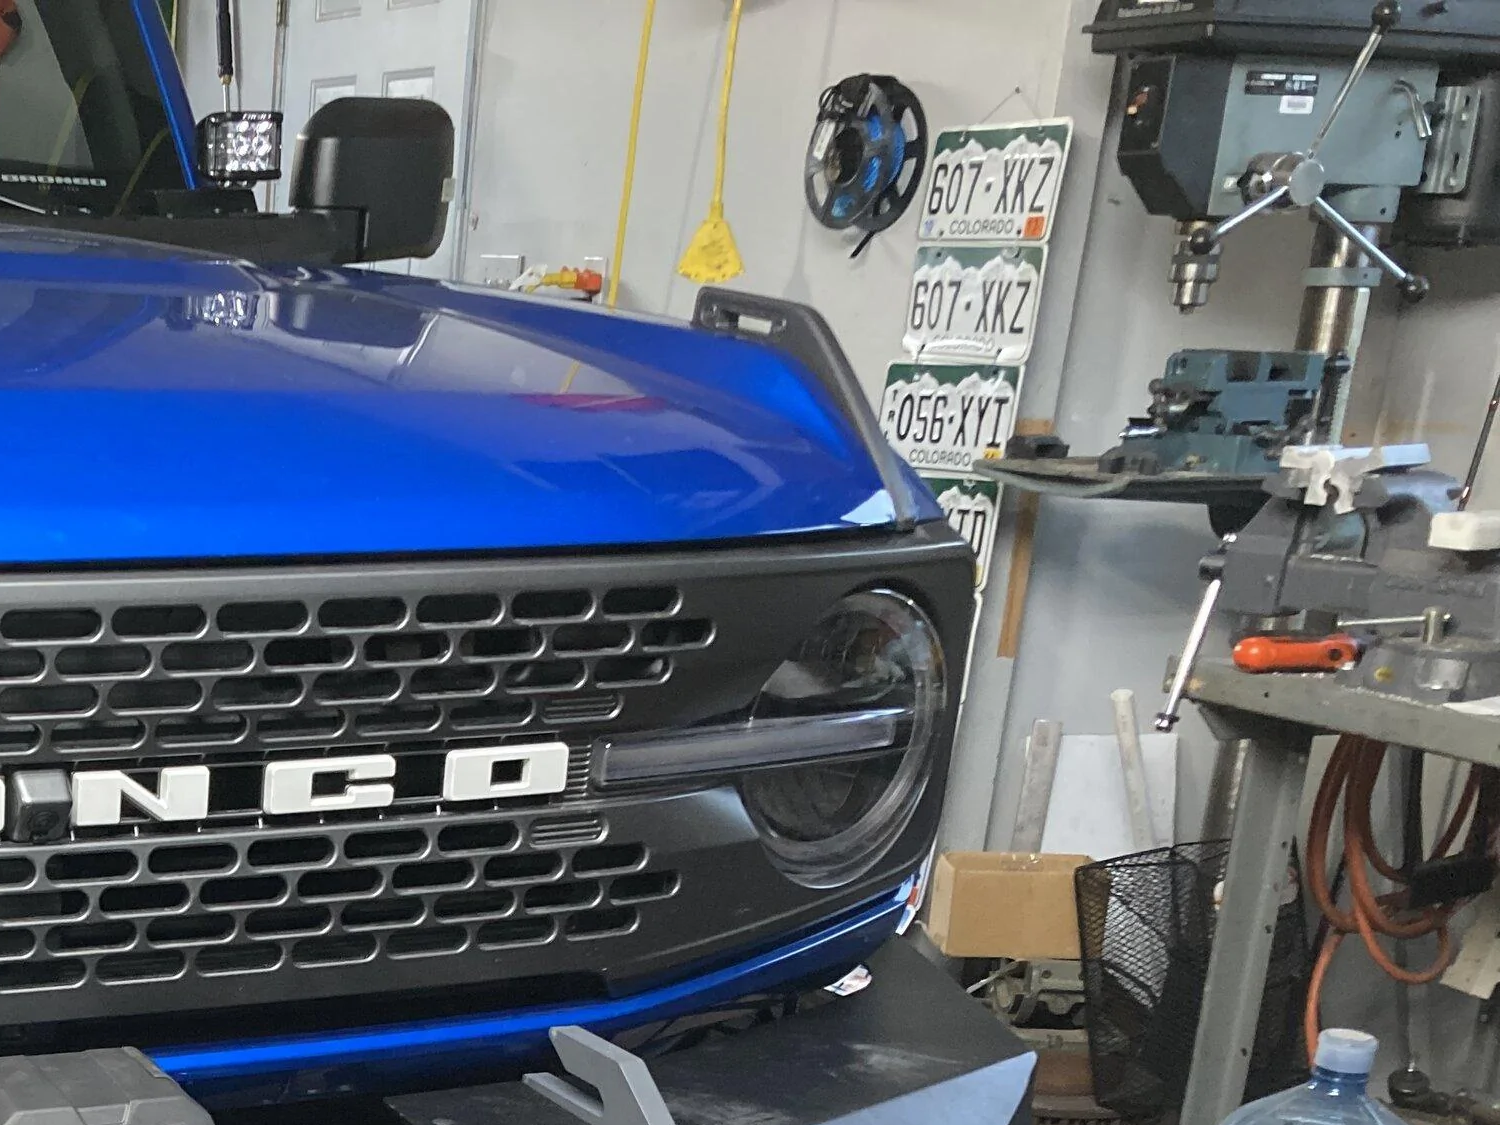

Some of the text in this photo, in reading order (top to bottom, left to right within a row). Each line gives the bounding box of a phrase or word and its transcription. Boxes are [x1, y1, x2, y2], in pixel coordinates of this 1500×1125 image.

[1, 173, 108, 187] BRONCO
[949, 218, 1014, 235] COLORADO
[908, 449, 972, 467] COLORADO
